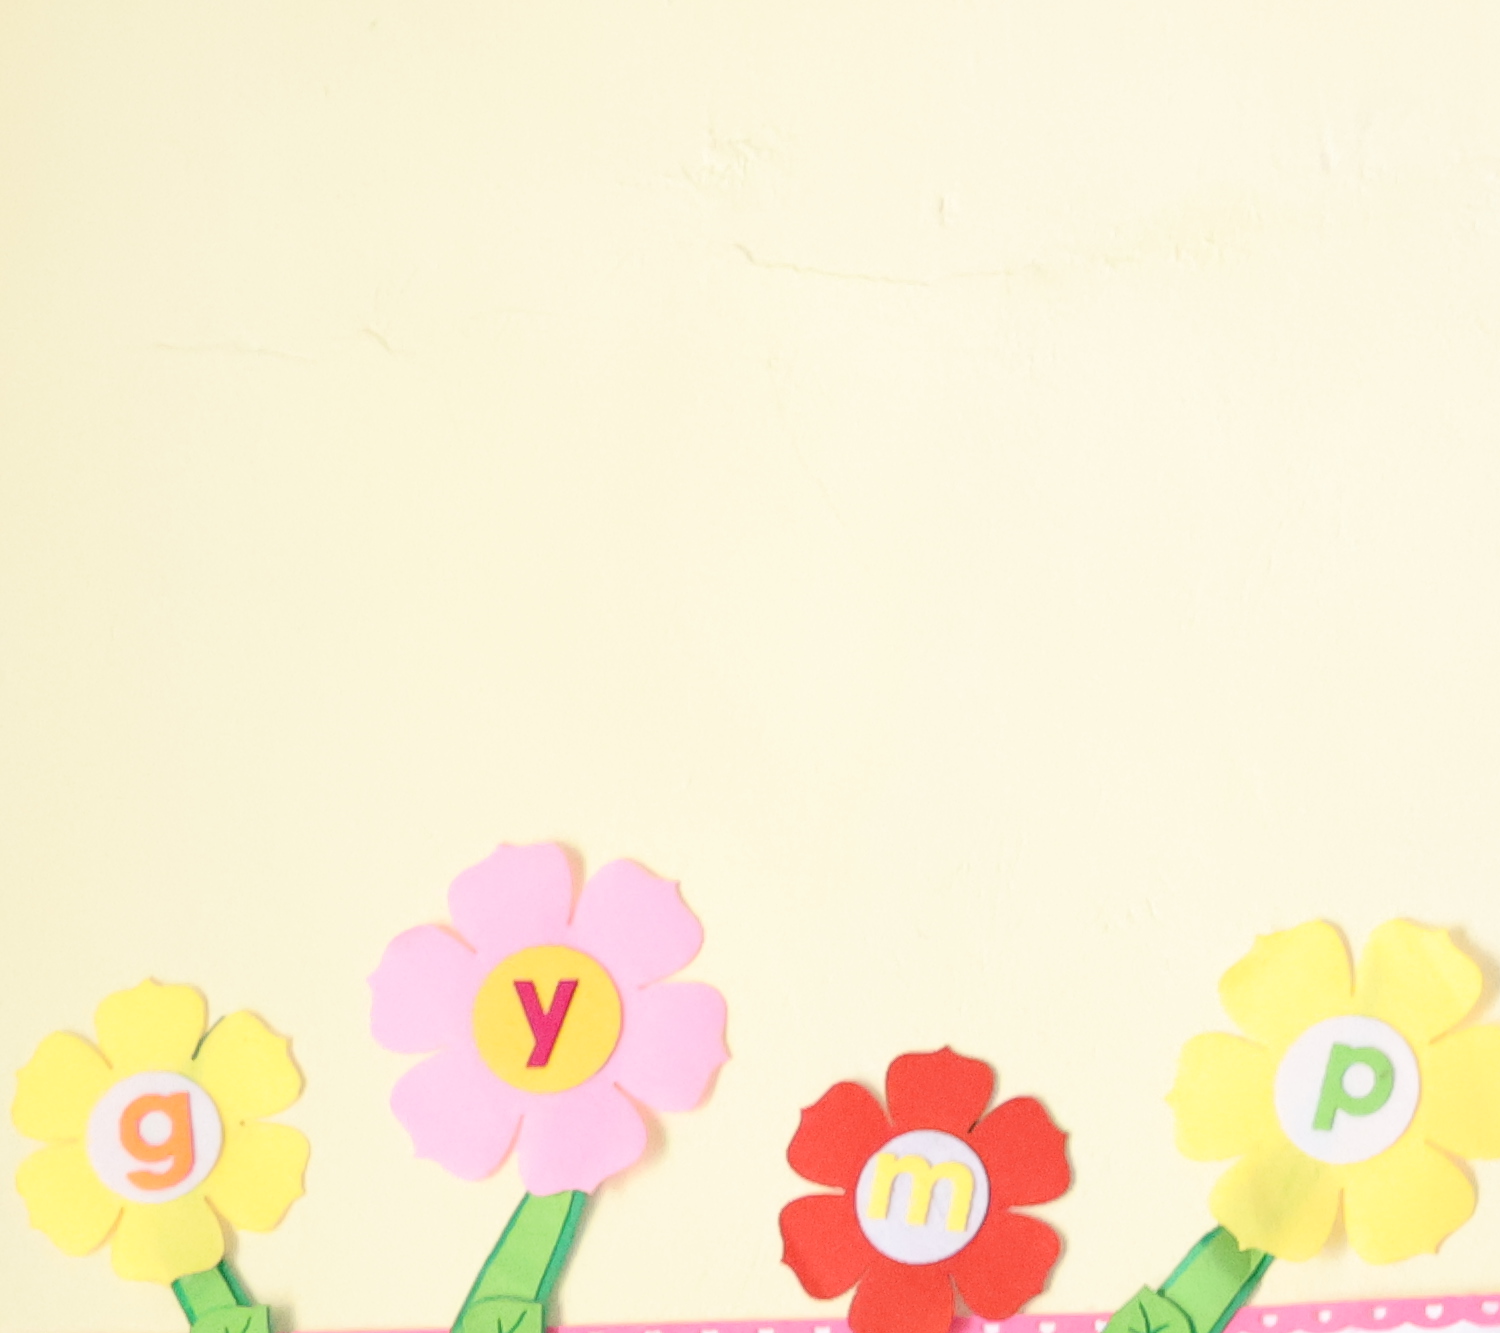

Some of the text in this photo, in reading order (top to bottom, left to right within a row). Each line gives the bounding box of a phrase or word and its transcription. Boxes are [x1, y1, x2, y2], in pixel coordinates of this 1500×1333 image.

[514, 980, 578, 1067] y
[1312, 1041, 1395, 1131] p
[119, 1090, 194, 1190] g
[867, 1151, 975, 1232] m
